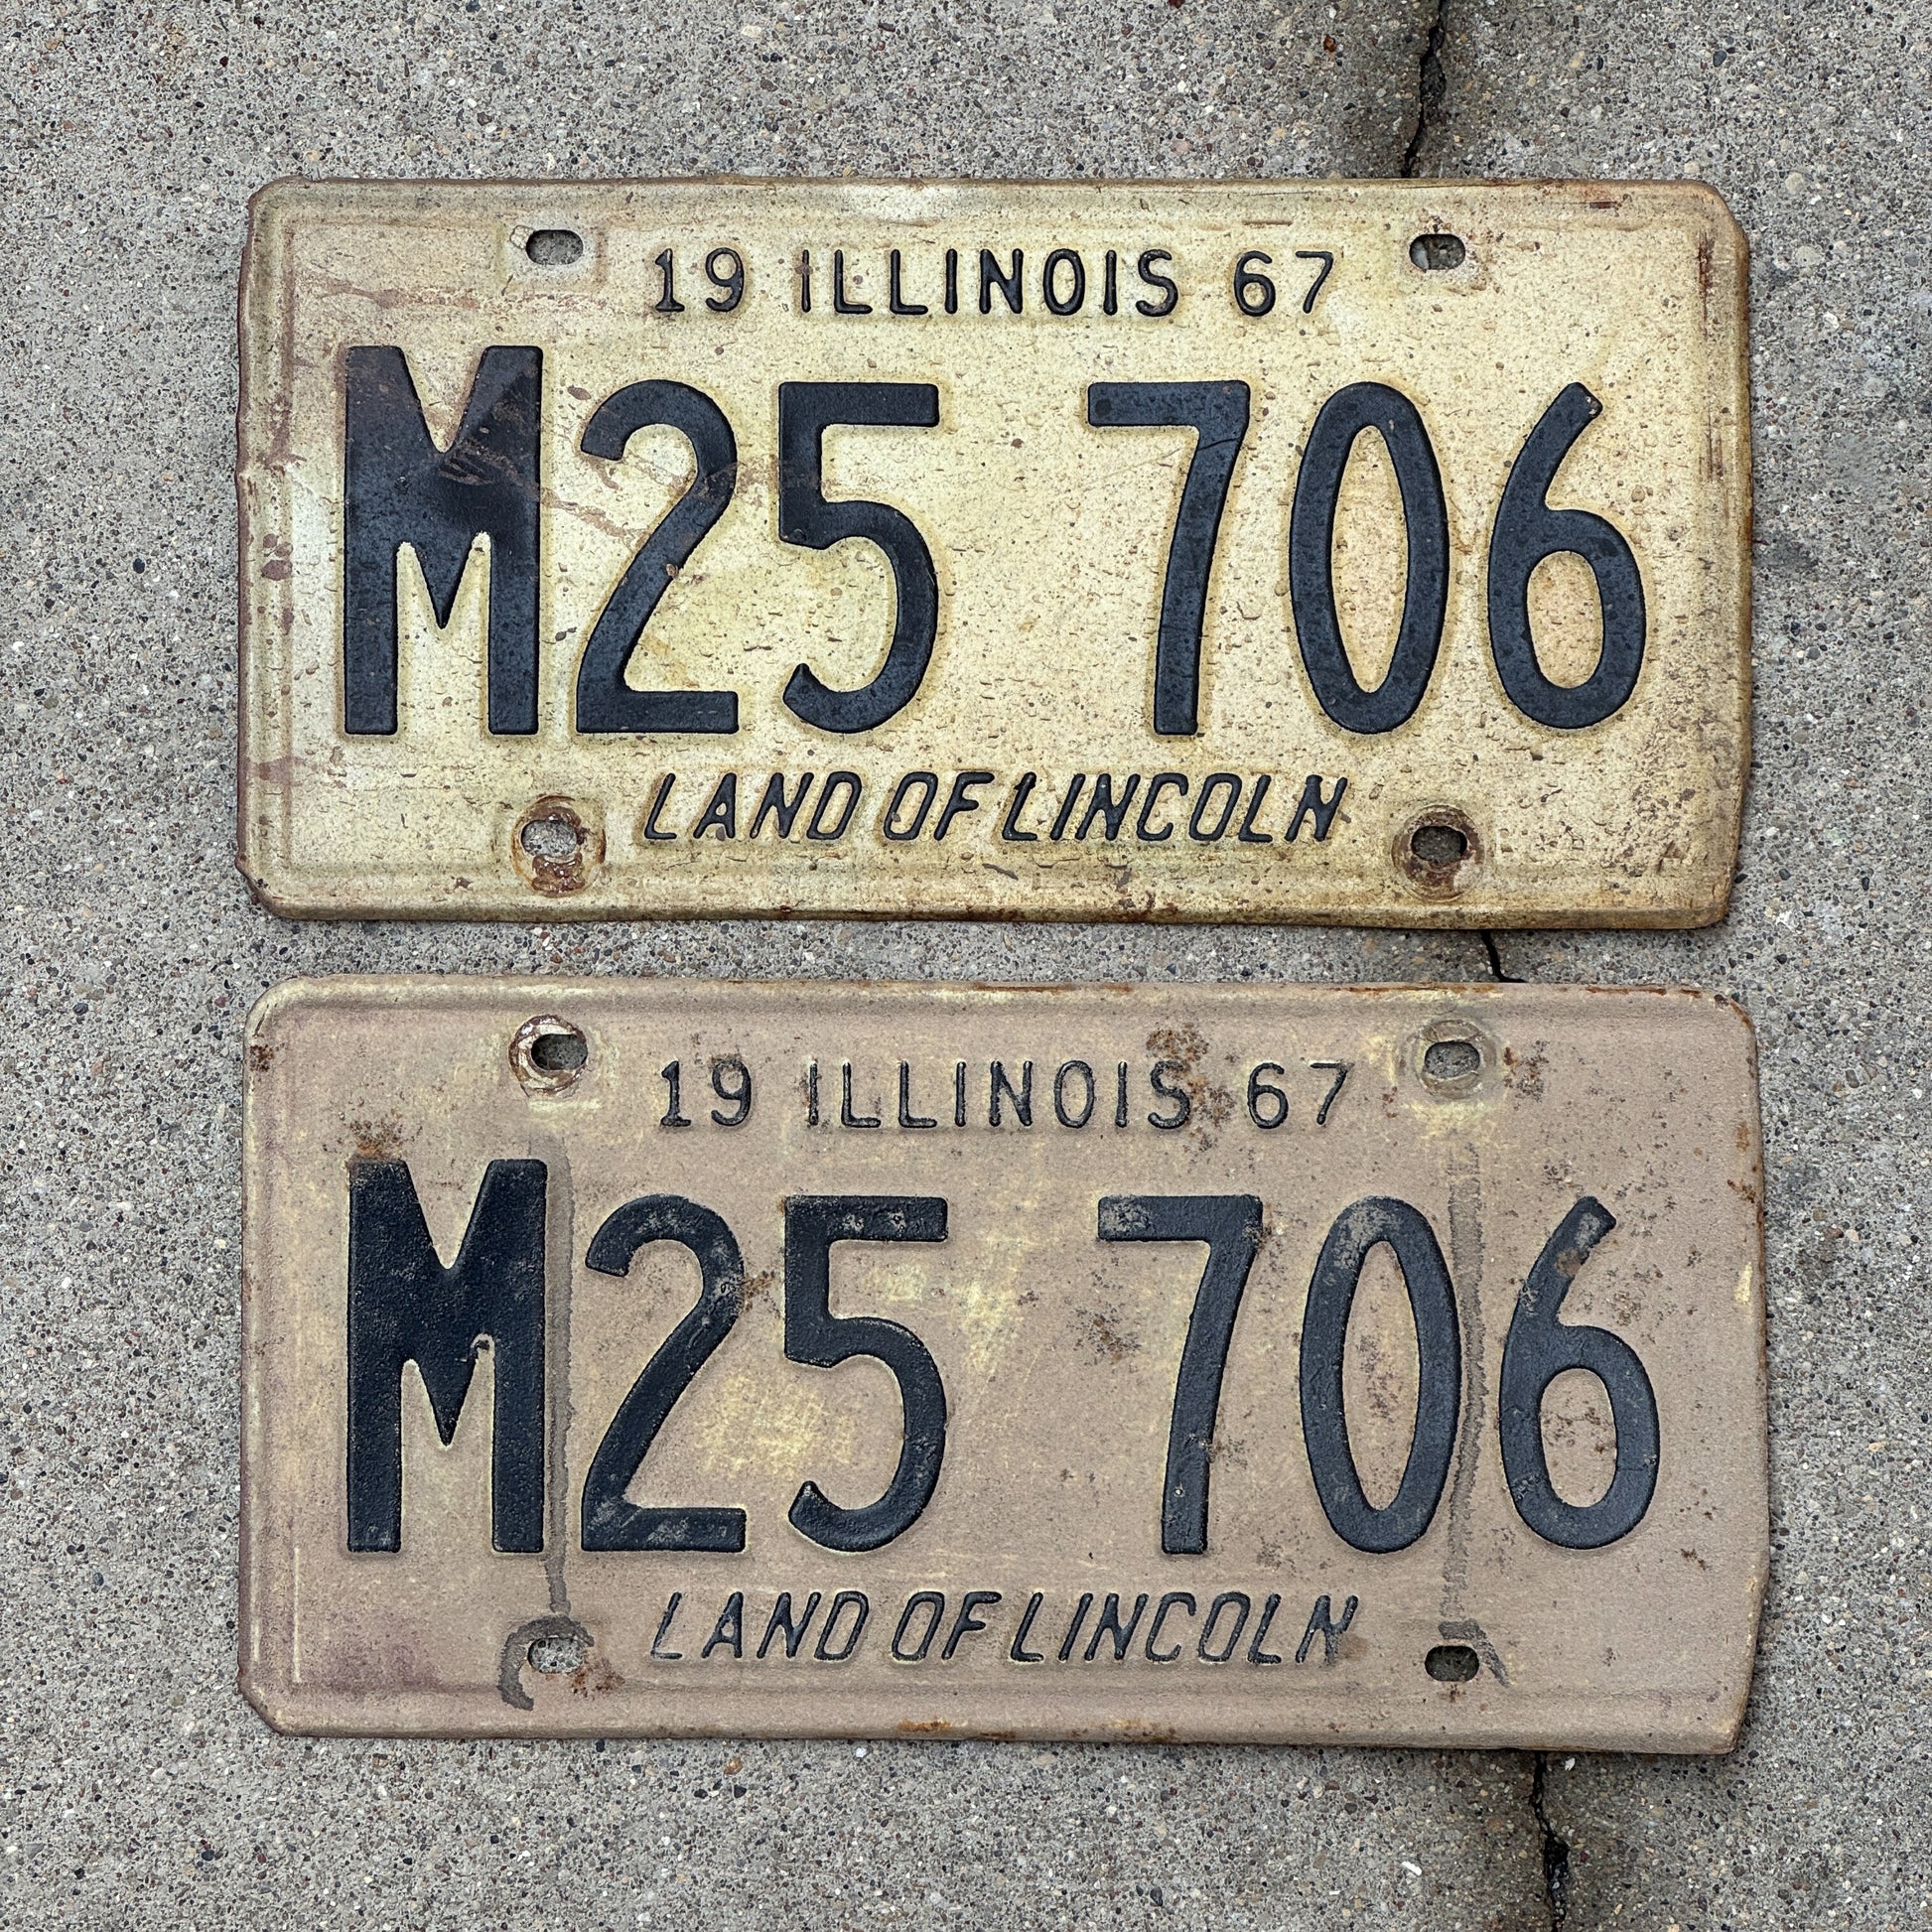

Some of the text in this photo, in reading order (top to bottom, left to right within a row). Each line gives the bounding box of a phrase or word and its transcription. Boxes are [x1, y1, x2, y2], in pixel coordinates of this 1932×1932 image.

[653, 246, 1335, 317] 19 ILLINOIS 67
[344, 345, 1646, 735] M25 706
[644, 771, 1349, 843] LAND OF LINCOLN
[659, 1059, 1351, 1130] 19 ILLINOIS 67
[347, 1159, 1661, 1555] M25 706
[651, 1589, 1359, 1665] LAND OF LINCOLN
